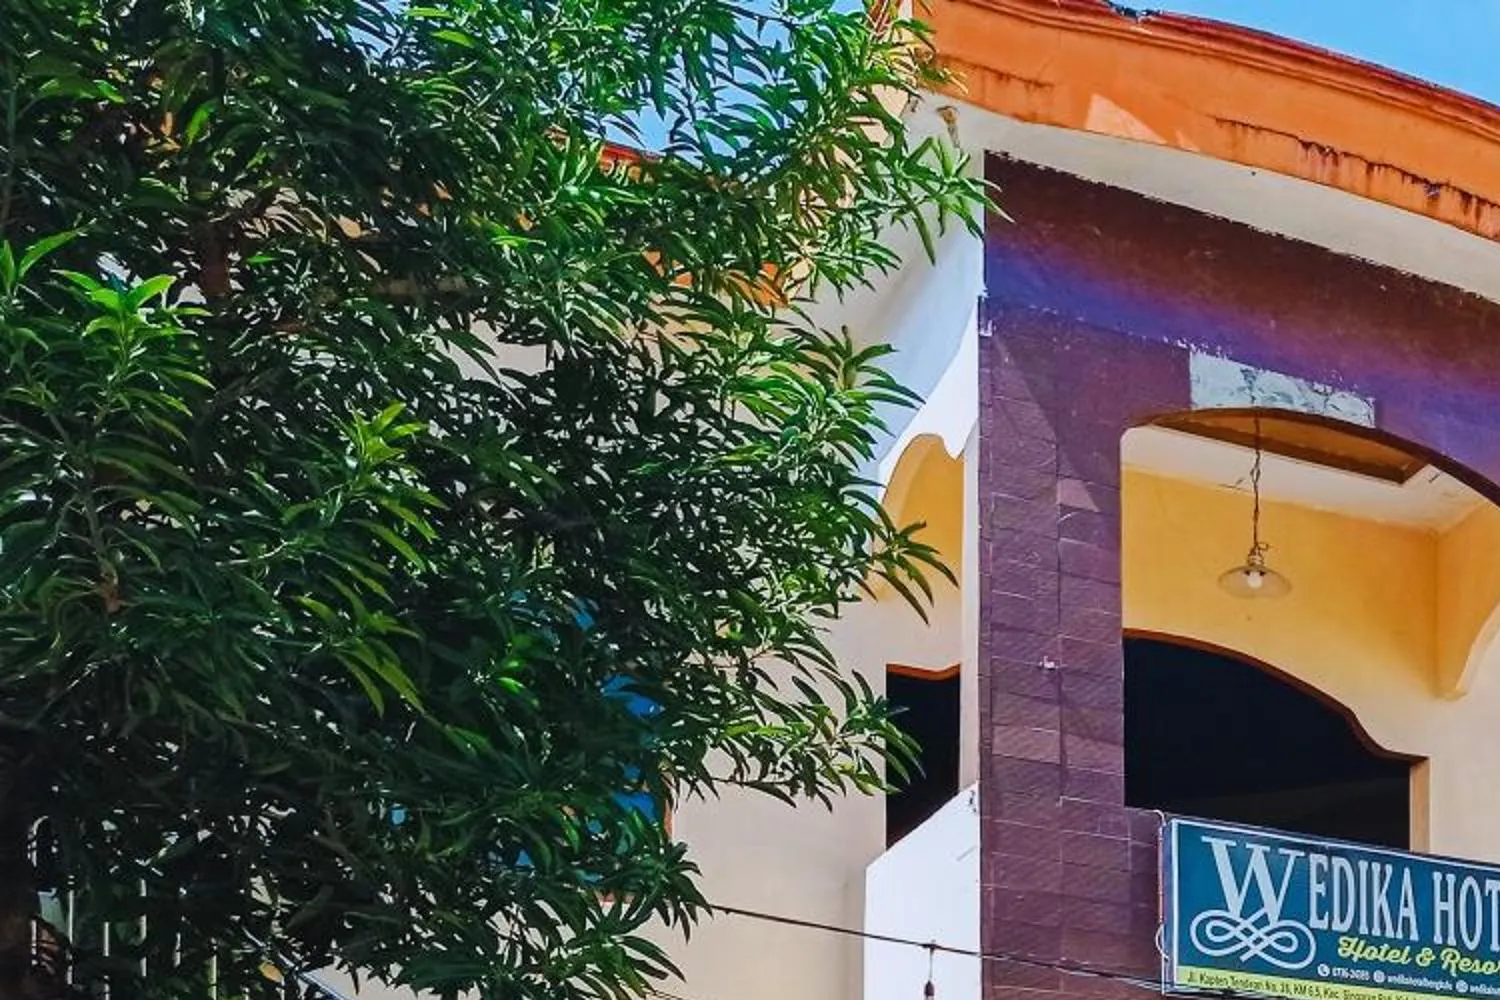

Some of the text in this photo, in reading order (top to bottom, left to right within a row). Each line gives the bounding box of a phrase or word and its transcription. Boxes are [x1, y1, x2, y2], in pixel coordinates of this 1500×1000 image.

[1201, 835, 1419, 942] WEDIKA
[1338, 936, 1412, 964] Hotel
[1415, 947, 1436, 967] &
[1293, 983, 1308, 995] KM
